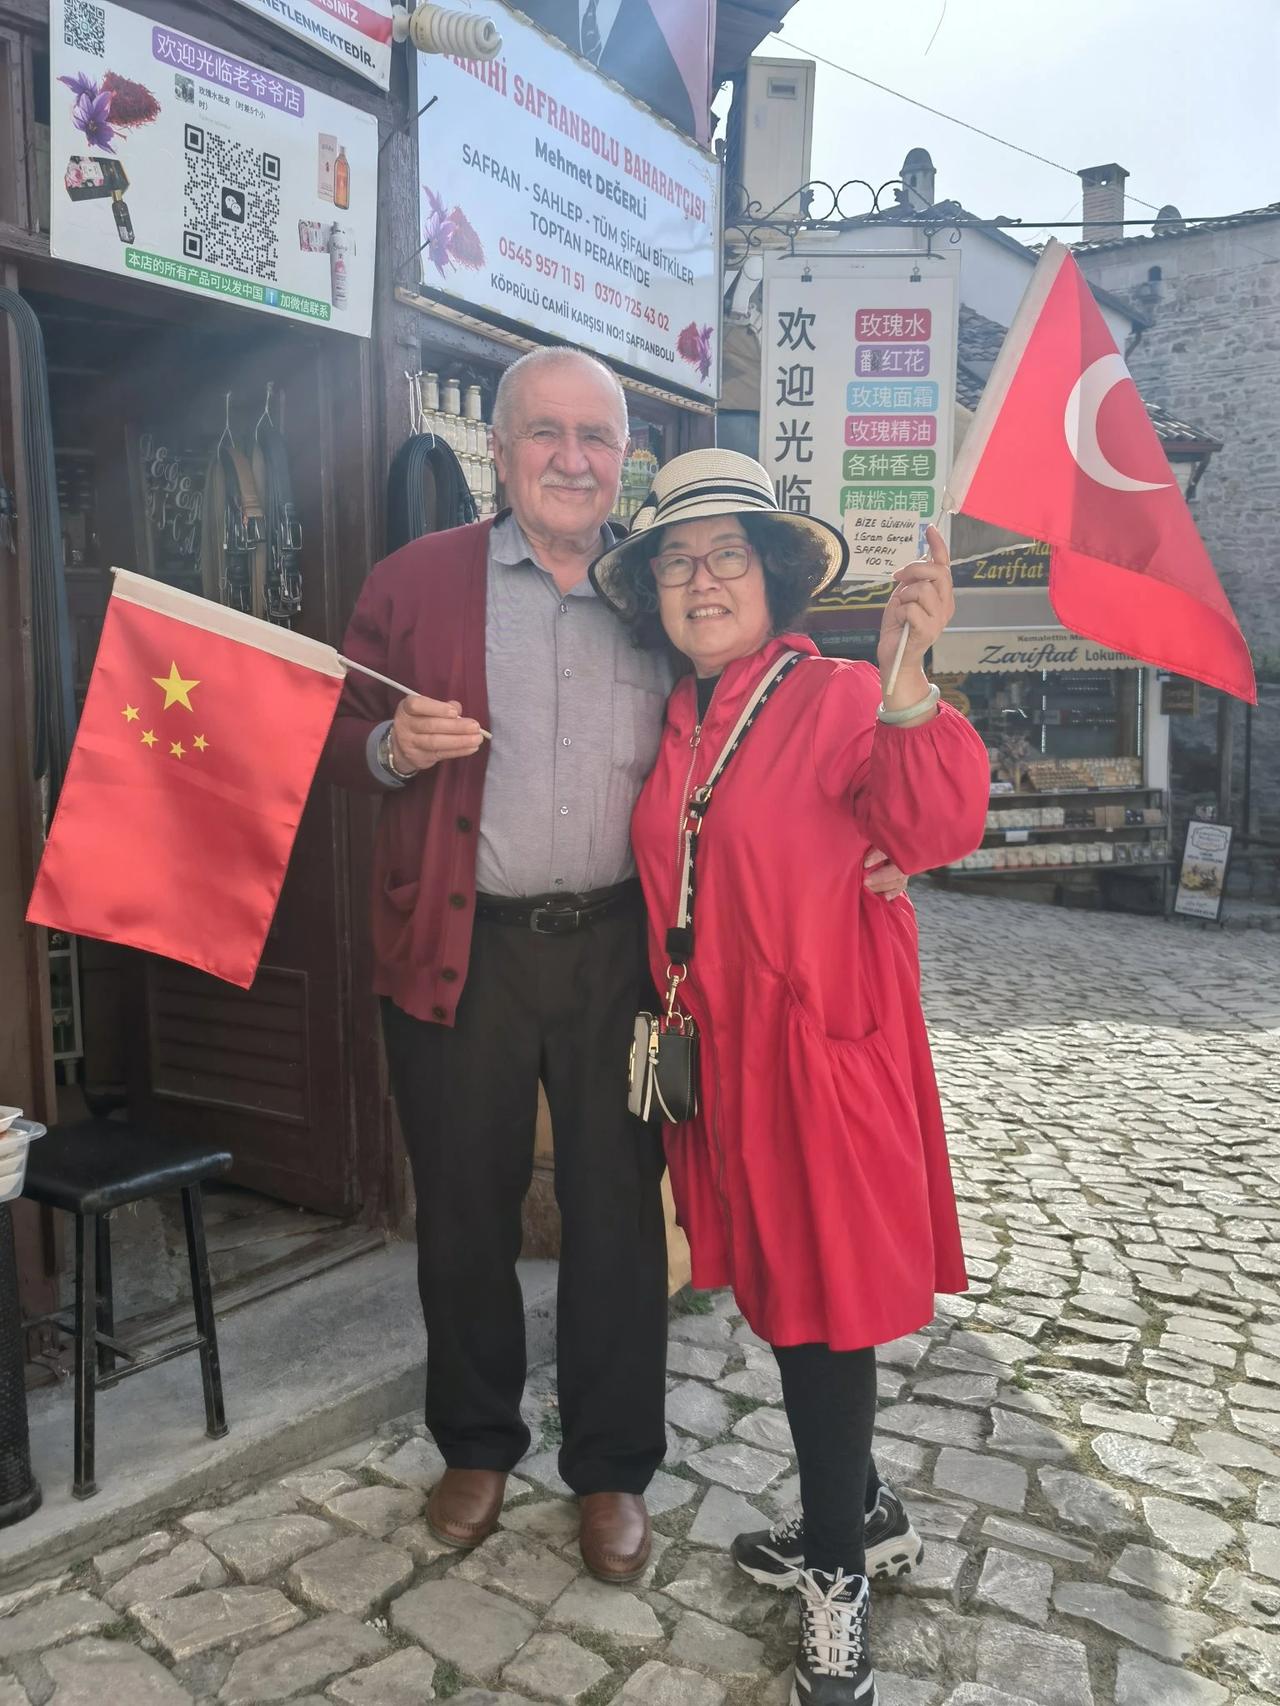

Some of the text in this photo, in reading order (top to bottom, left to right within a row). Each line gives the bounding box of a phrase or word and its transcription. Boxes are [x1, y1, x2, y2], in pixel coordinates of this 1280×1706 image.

[157, 33, 301, 113] 欢迎光临老爷爷店
[514, 74, 619, 167] SAFRANBOLU
[624, 146, 706, 224] BAHARATÇISI
[535, 136, 647, 221] Mehmet DEĞERLİ
[462, 143, 520, 193] SAFRAN
[533, 183, 583, 223] SAHLEP
[593, 214, 618, 244] TÜM
[620, 228, 651, 262] ŞİFALI
[653, 247, 694, 287] BİTKİLER
[530, 211, 650, 288] TOPTAN PERAKENDE
[128, 252, 329, 318] 本店的所有产品可以发中国 加微信联系
[499, 236, 670, 332] 0545 957 11 51 0370 725 43 02
[490, 272, 540, 307] KÖPRÜLÜ
[571, 307, 604, 334] KARŞISI
[606, 322, 625, 342] NO:1
[626, 331, 675, 363] SAFRANBOLU
[860, 313, 926, 337] 玫瑰水
[773, 306, 817, 515] 欢迎光临
[851, 386, 934, 408] 玫瑰面霜
[850, 421, 932, 443] 玫瑰精油
[847, 454, 930, 477] 各种香皂
[844, 489, 929, 513] 橄榄油霜
[854, 545, 897, 555] SAFRAN
[865, 557, 882, 566] 100
[972, 557, 1044, 585] Zariftat
[978, 643, 1079, 669] Zariftat
